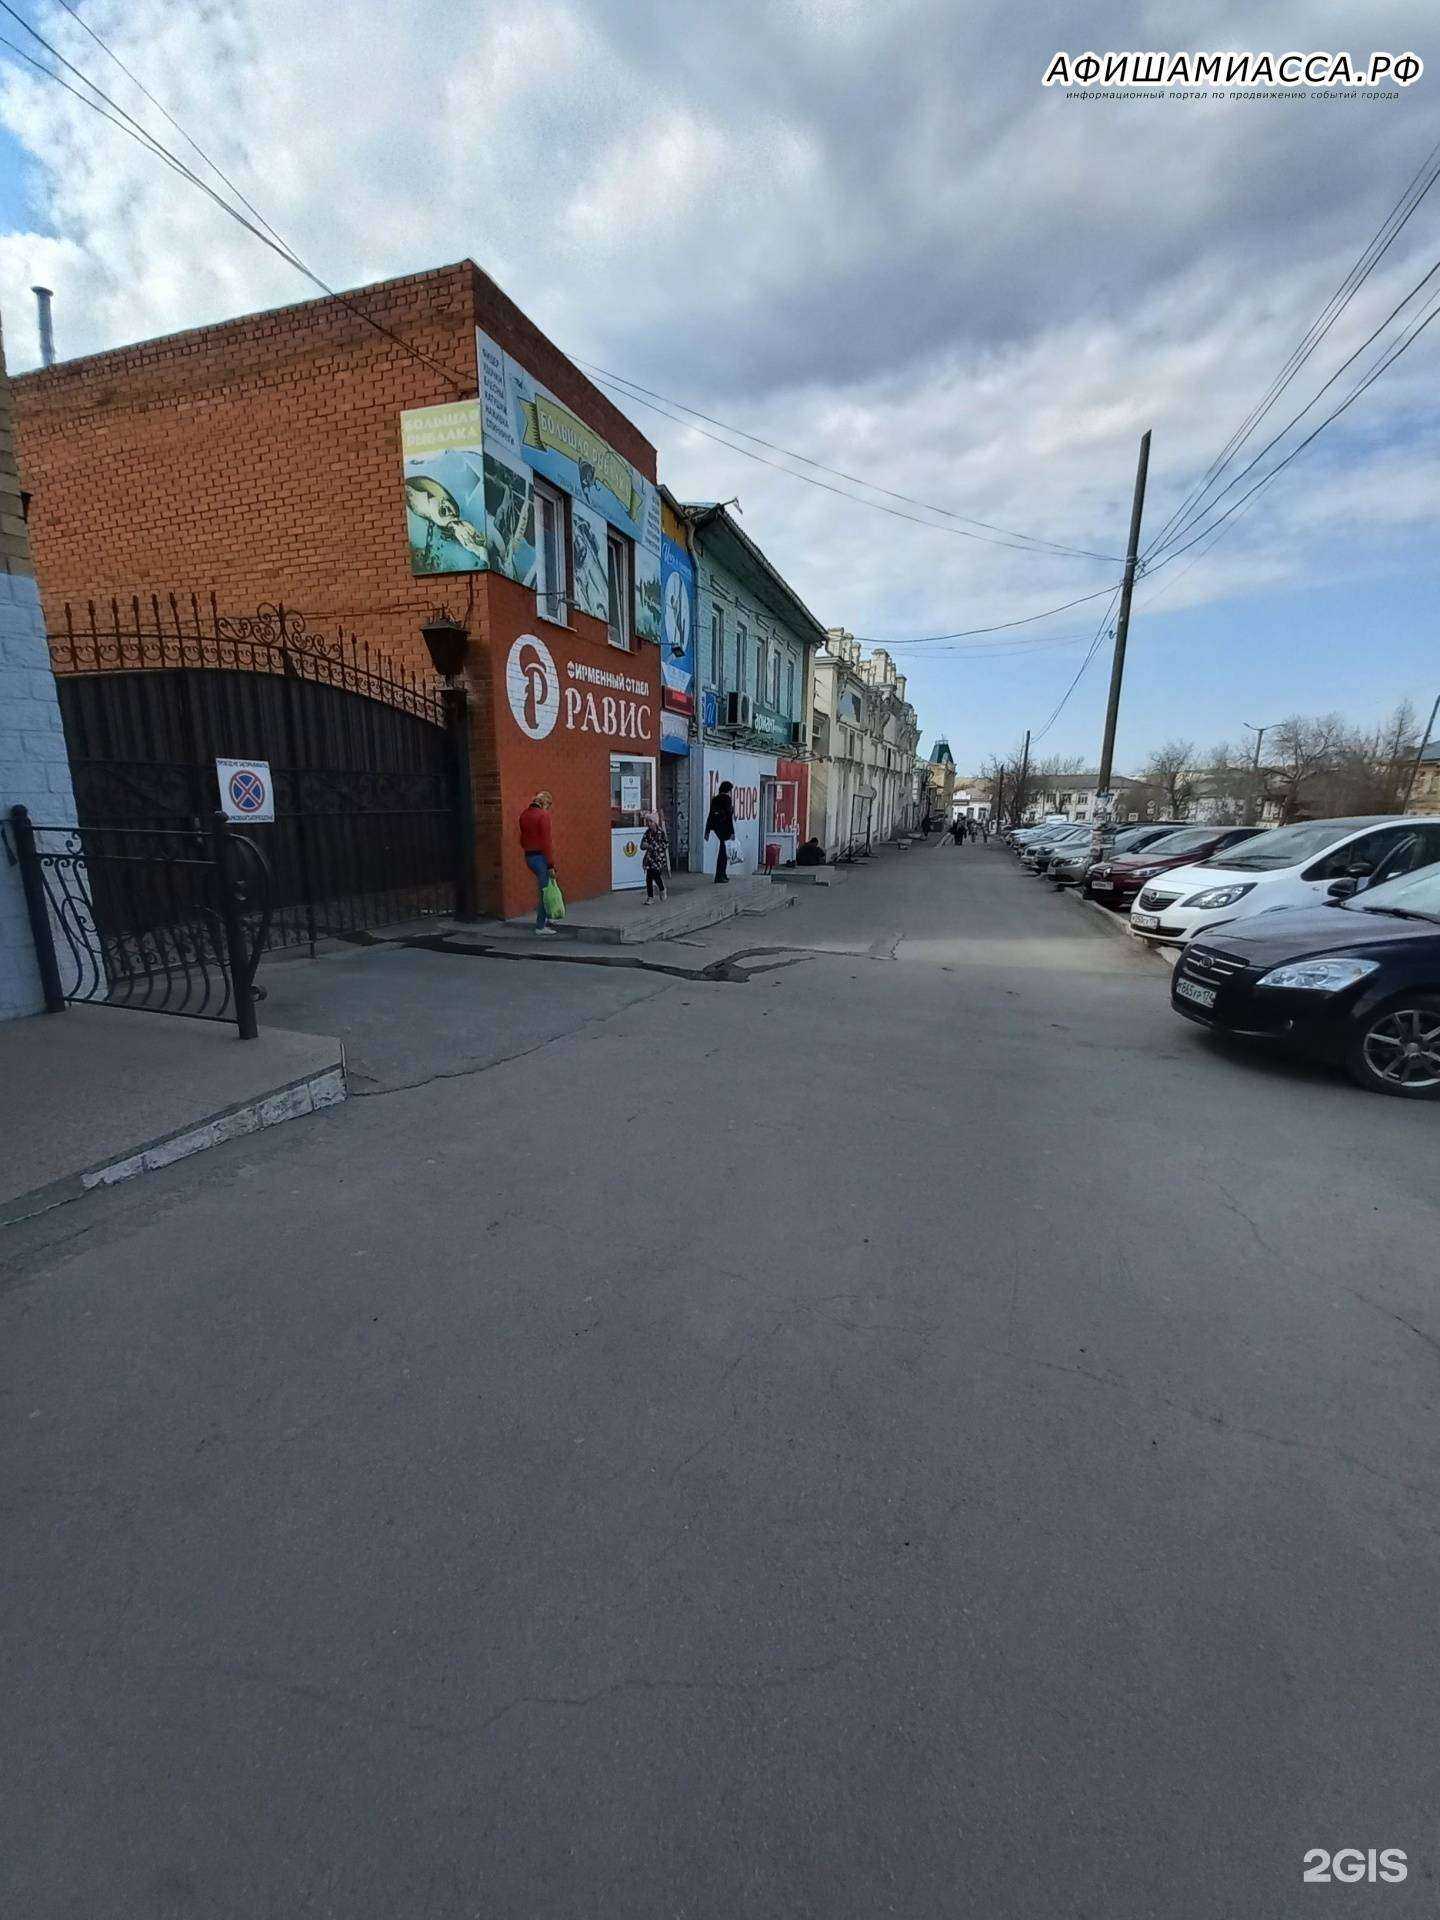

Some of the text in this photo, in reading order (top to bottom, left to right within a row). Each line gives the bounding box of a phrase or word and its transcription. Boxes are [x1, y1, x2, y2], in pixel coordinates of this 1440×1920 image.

[539, 410, 590, 456] БОЛЬШАЯ
[566, 660, 625, 691] ФИРМЕННЫЙ
[625, 677, 650, 697] ОТДЕЛ
[565, 687, 652, 740] РАВИС
